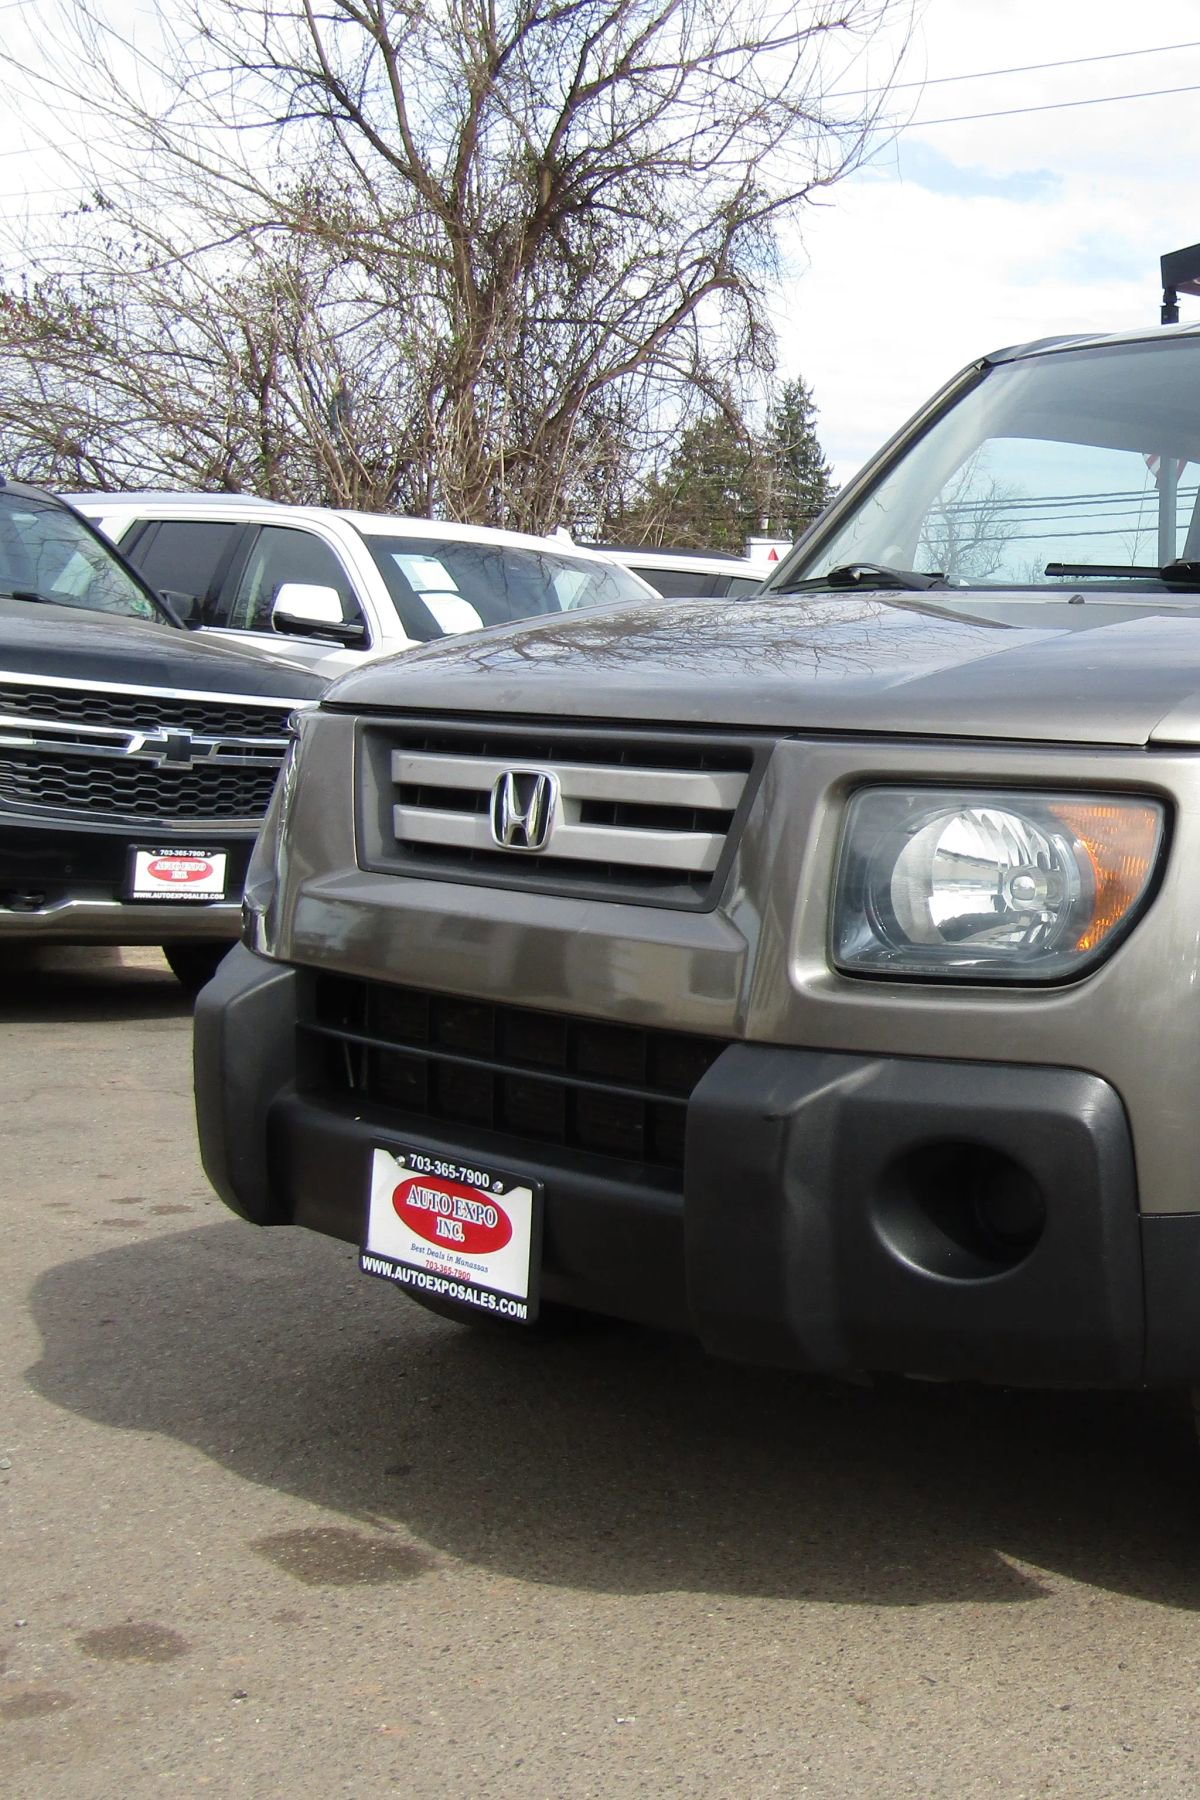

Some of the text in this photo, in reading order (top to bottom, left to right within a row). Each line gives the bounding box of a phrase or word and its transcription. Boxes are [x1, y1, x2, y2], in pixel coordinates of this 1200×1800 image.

[410, 1154, 490, 1188] 703-365-7900
[406, 1184, 498, 1228] AUTO EXPO
[436, 1216, 465, 1242] INC.
[410, 1243, 489, 1273] Best Deals in Manassas
[425, 1259, 471, 1281] 703-365-7900
[362, 1256, 528, 1320] WWW.AUTOEXPOSALES.COM
